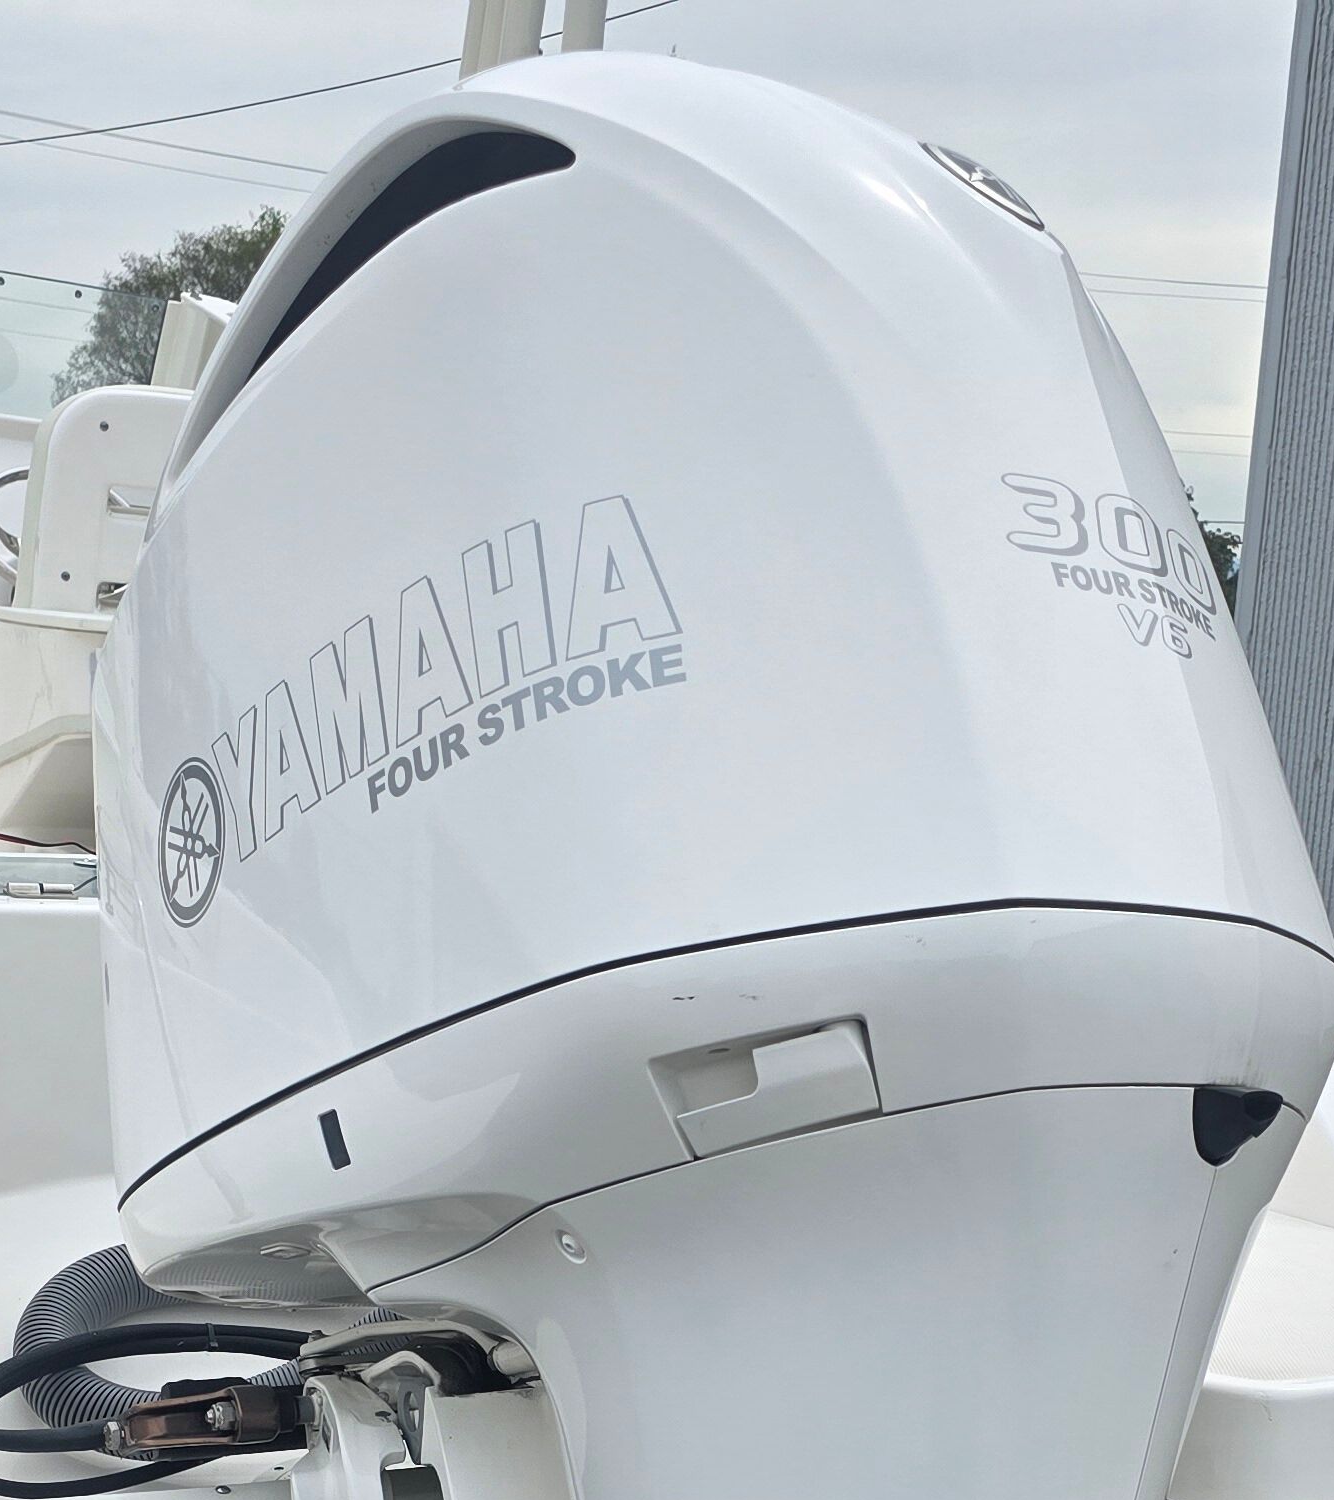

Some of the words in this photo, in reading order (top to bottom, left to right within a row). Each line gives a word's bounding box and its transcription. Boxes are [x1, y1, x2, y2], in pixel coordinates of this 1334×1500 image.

[1001, 473, 1216, 614] 300
[1051, 562, 1136, 600] FOUR
[1138, 577, 1217, 642] STROKE
[211, 494, 683, 862] YAMAHA
[1117, 603, 1193, 660] V6
[368, 725, 470, 813] FOUR
[478, 643, 686, 747] STROKE
